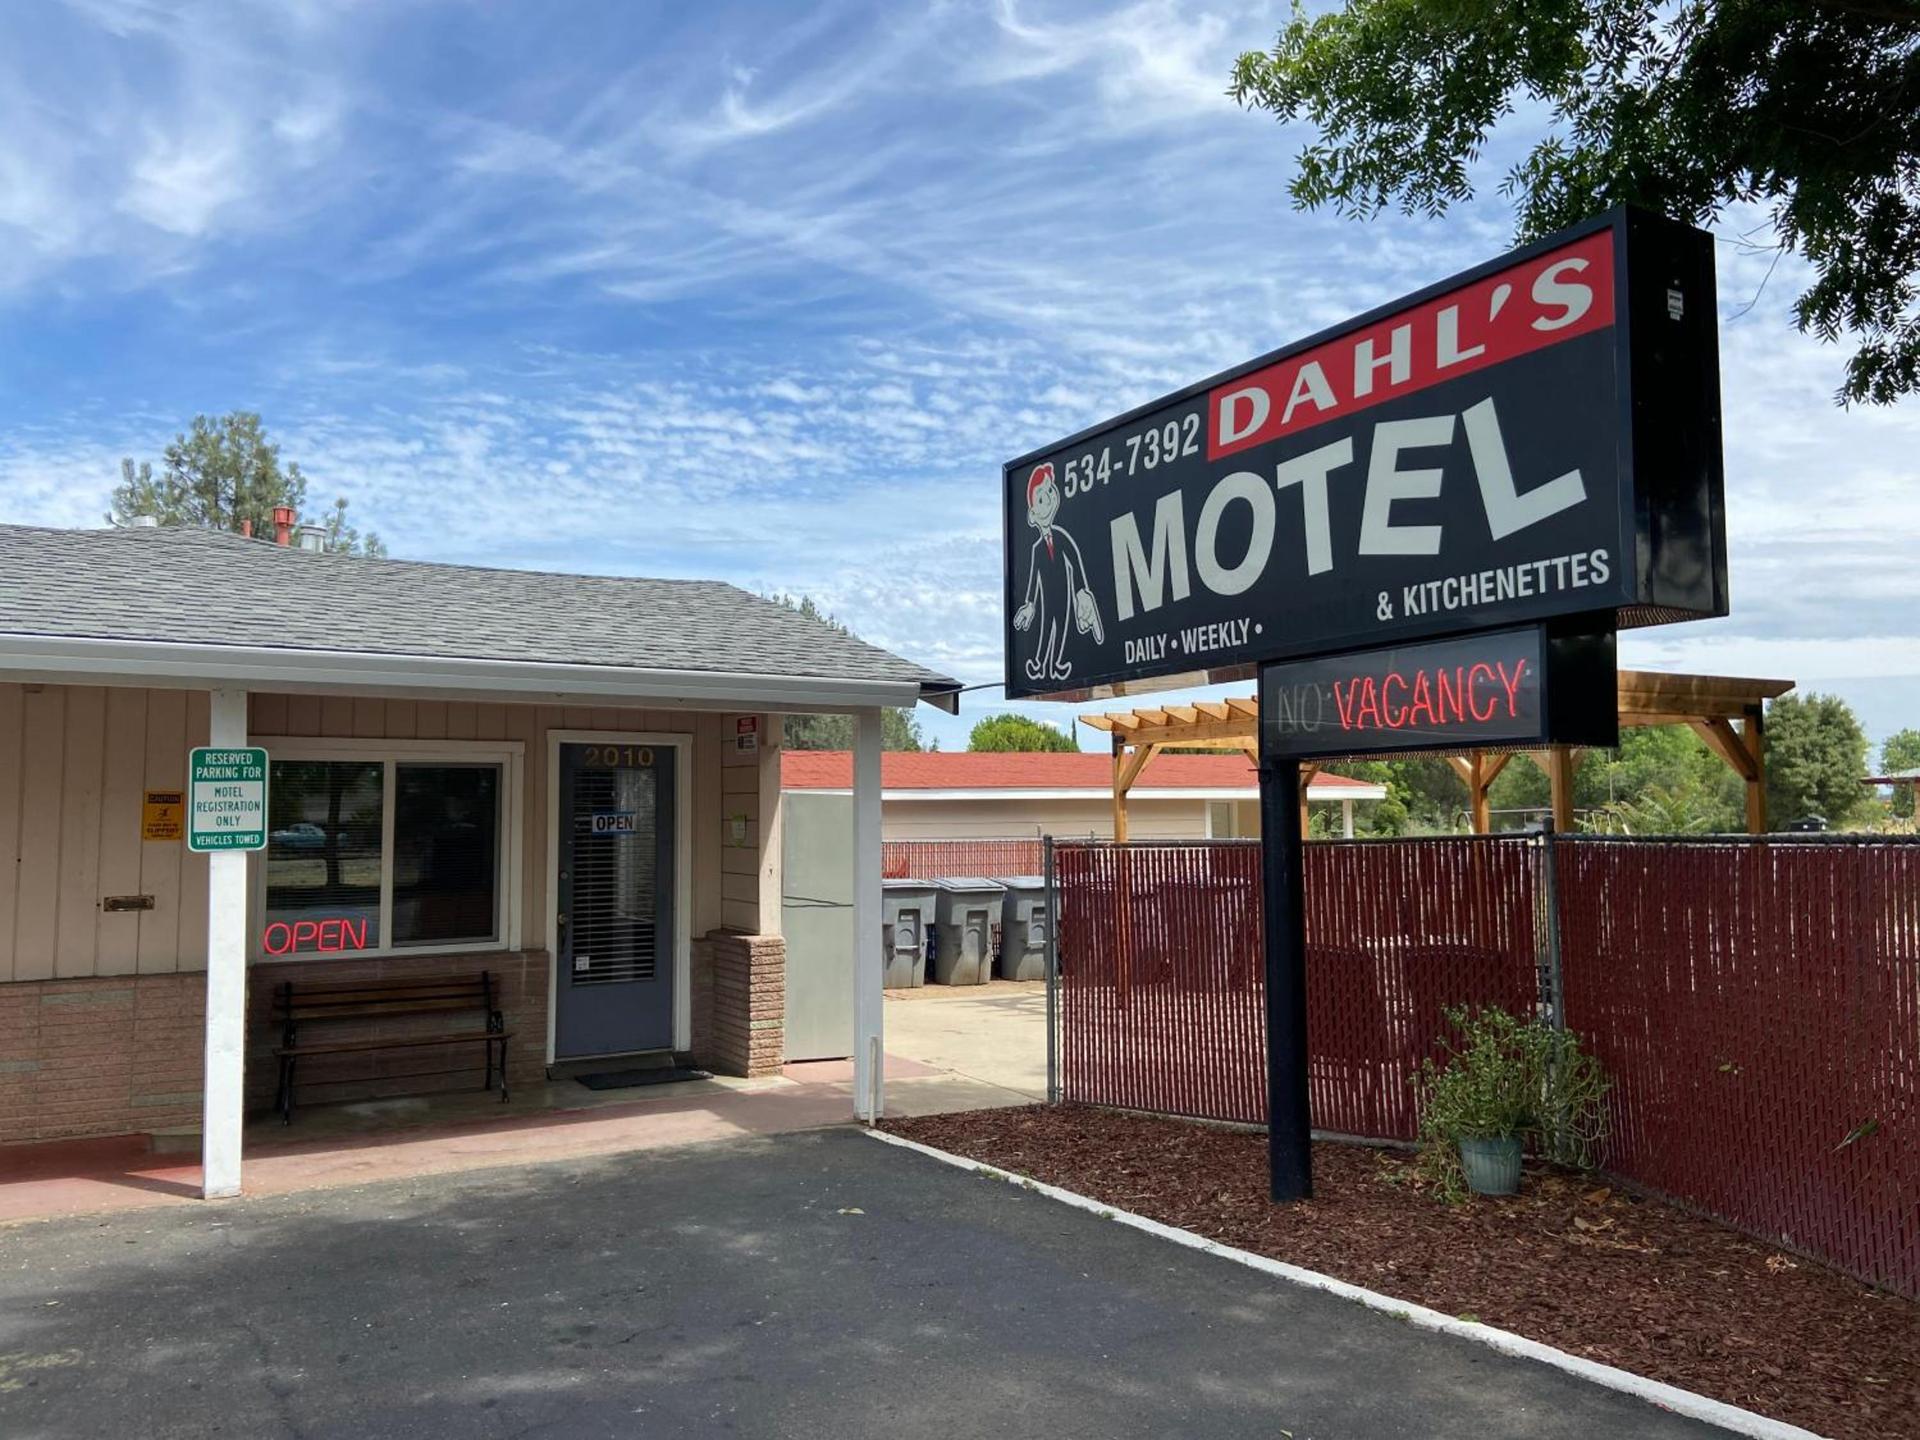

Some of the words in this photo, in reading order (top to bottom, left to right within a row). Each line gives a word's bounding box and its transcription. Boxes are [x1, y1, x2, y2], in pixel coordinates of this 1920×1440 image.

[1219, 257, 1594, 446] DAHL'S
[1064, 412, 1200, 499] 534-7392
[1110, 396, 1588, 622] MOTEL
[1125, 633, 1167, 664] DAILY
[1181, 617, 1250, 655] WEEKLY
[1376, 590, 1394, 622] &
[1403, 548, 1610, 617] KITCHENETTES
[1278, 683, 1322, 734] NO
[1333, 658, 1526, 730] VACANCY
[205, 753, 253, 765] RESERVED
[584, 746, 654, 768] 2010
[196, 766, 239, 779] PARKING
[243, 766, 262, 779] FOR
[214, 786, 244, 798] MOTEL
[196, 800, 261, 813] REGISTRATION
[215, 815, 241, 827] ONLY
[595, 815, 633, 831] OPEN
[196, 835, 233, 846] VEHICLES
[235, 834, 260, 845] TOWED
[263, 918, 368, 955] OPEN
